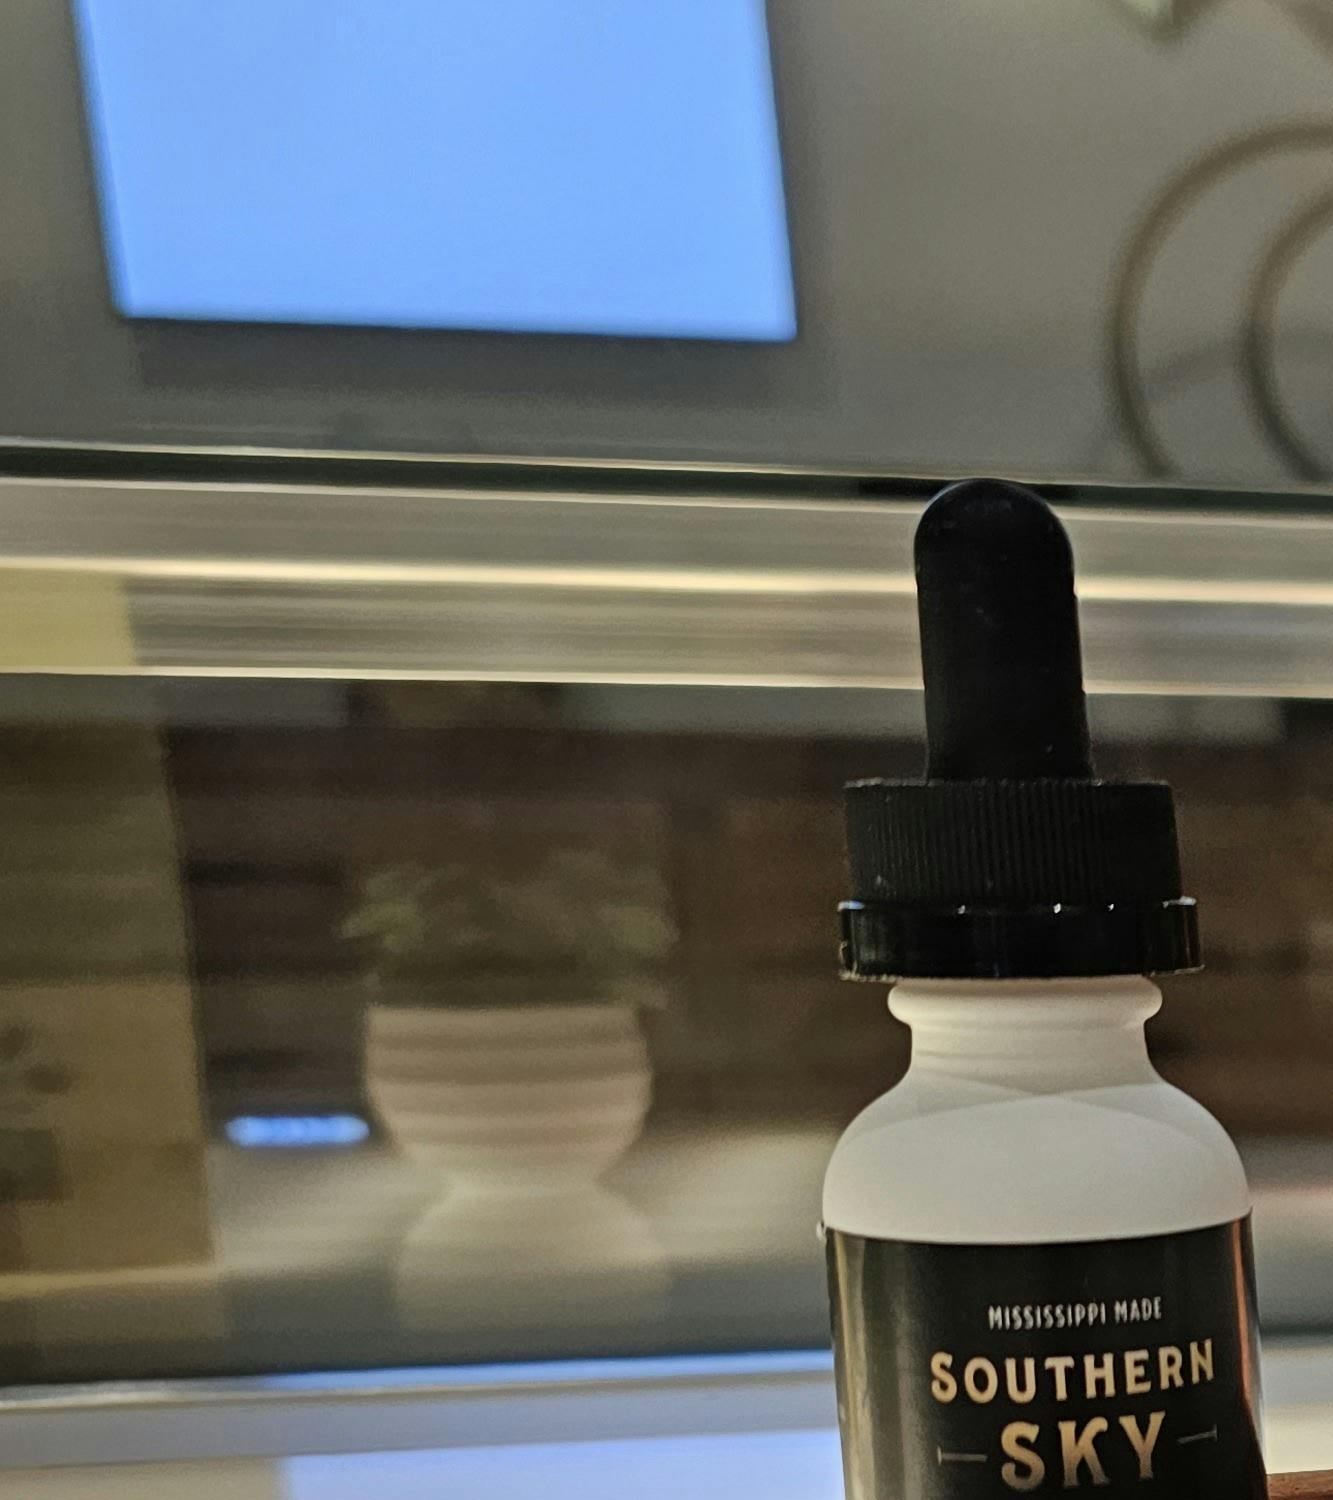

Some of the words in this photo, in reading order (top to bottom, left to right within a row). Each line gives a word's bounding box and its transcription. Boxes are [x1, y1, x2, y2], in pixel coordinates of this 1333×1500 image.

[987, 1302, 1106, 1331] MISSISSIPPI
[1114, 1296, 1162, 1325] MADE
[930, 1338, 1215, 1404] SOUTHERN
[1001, 1411, 1167, 1491] SKY
